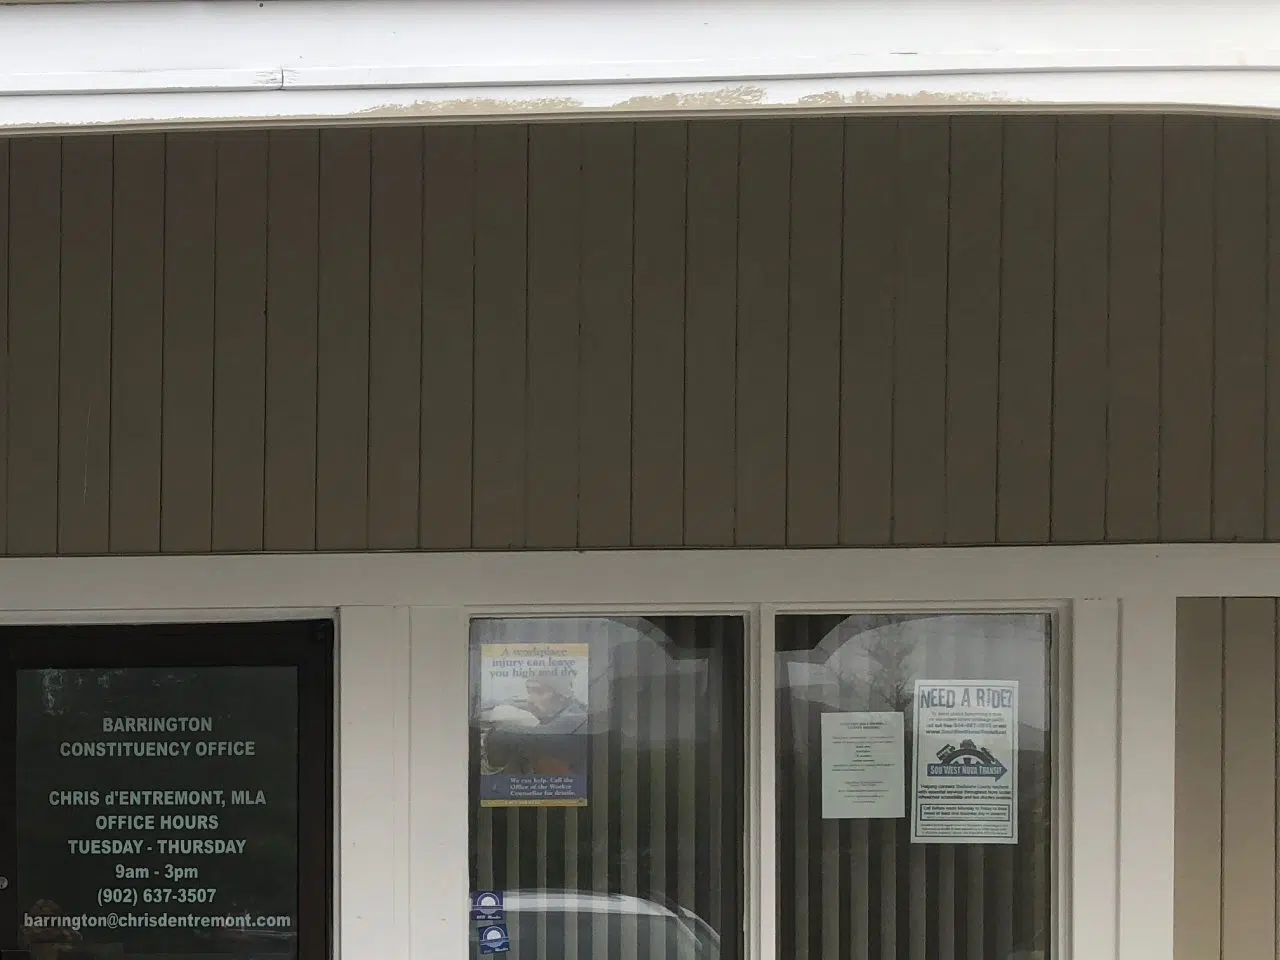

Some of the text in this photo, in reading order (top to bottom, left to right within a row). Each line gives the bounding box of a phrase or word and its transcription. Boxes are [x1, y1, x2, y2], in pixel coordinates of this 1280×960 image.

[512, 667, 535, 679] high
[920, 688, 956, 708] NEED
[961, 688, 971, 708] A
[103, 717, 212, 732] BARRINGTON
[60, 741, 255, 757] CONSTITUENCY OFFICE
[49, 790, 267, 808] CHRIS d'ENTREMONT, MLA
[95, 814, 219, 830] OFFICE HOURS
[67, 839, 144, 854] TUESDAY
[156, 839, 247, 854] THURSDAY
[115, 863, 150, 879] 9am
[164, 863, 198, 882] 3pm
[97, 887, 217, 906] (902) 637-3507
[24, 912, 291, 930] barrington@chrisdentremont.com
